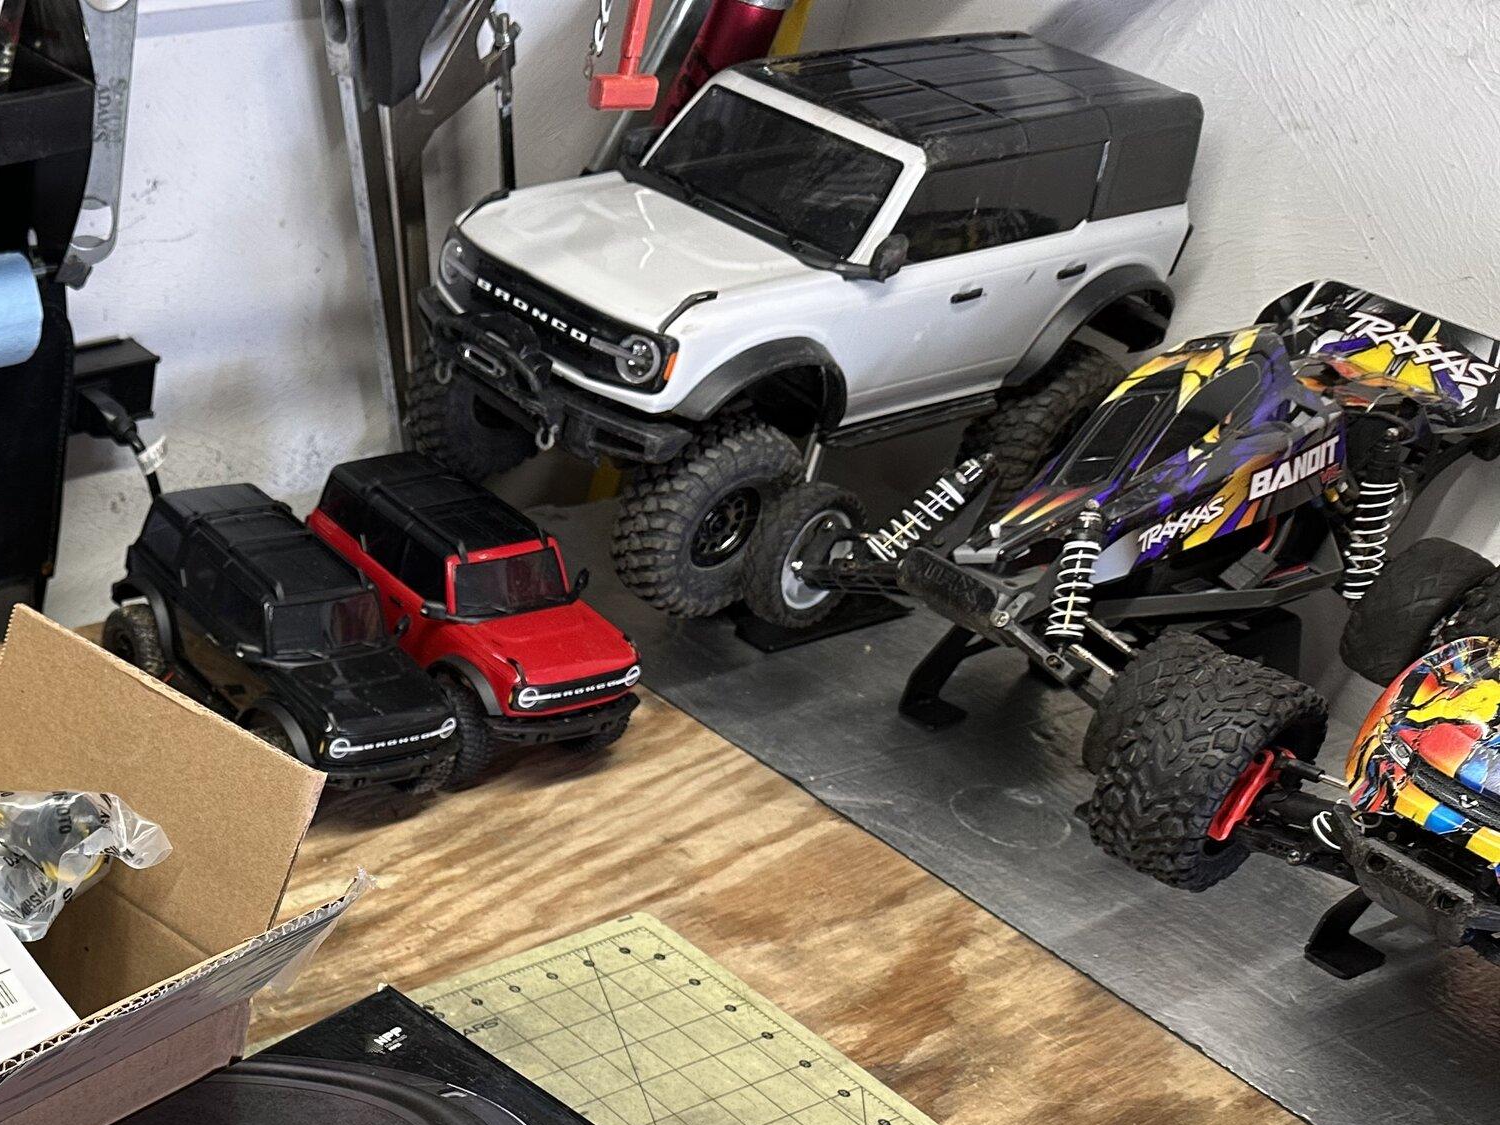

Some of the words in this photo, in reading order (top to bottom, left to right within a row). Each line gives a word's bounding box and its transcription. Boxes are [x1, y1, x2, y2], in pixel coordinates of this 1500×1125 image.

[476, 277, 589, 343] BRONCO
[1346, 311, 1493, 386] TRAXXAS
[1250, 435, 1340, 501] BANDIT
[1138, 497, 1226, 553] TRAXXAS
[373, 1026, 403, 1046] NPP
